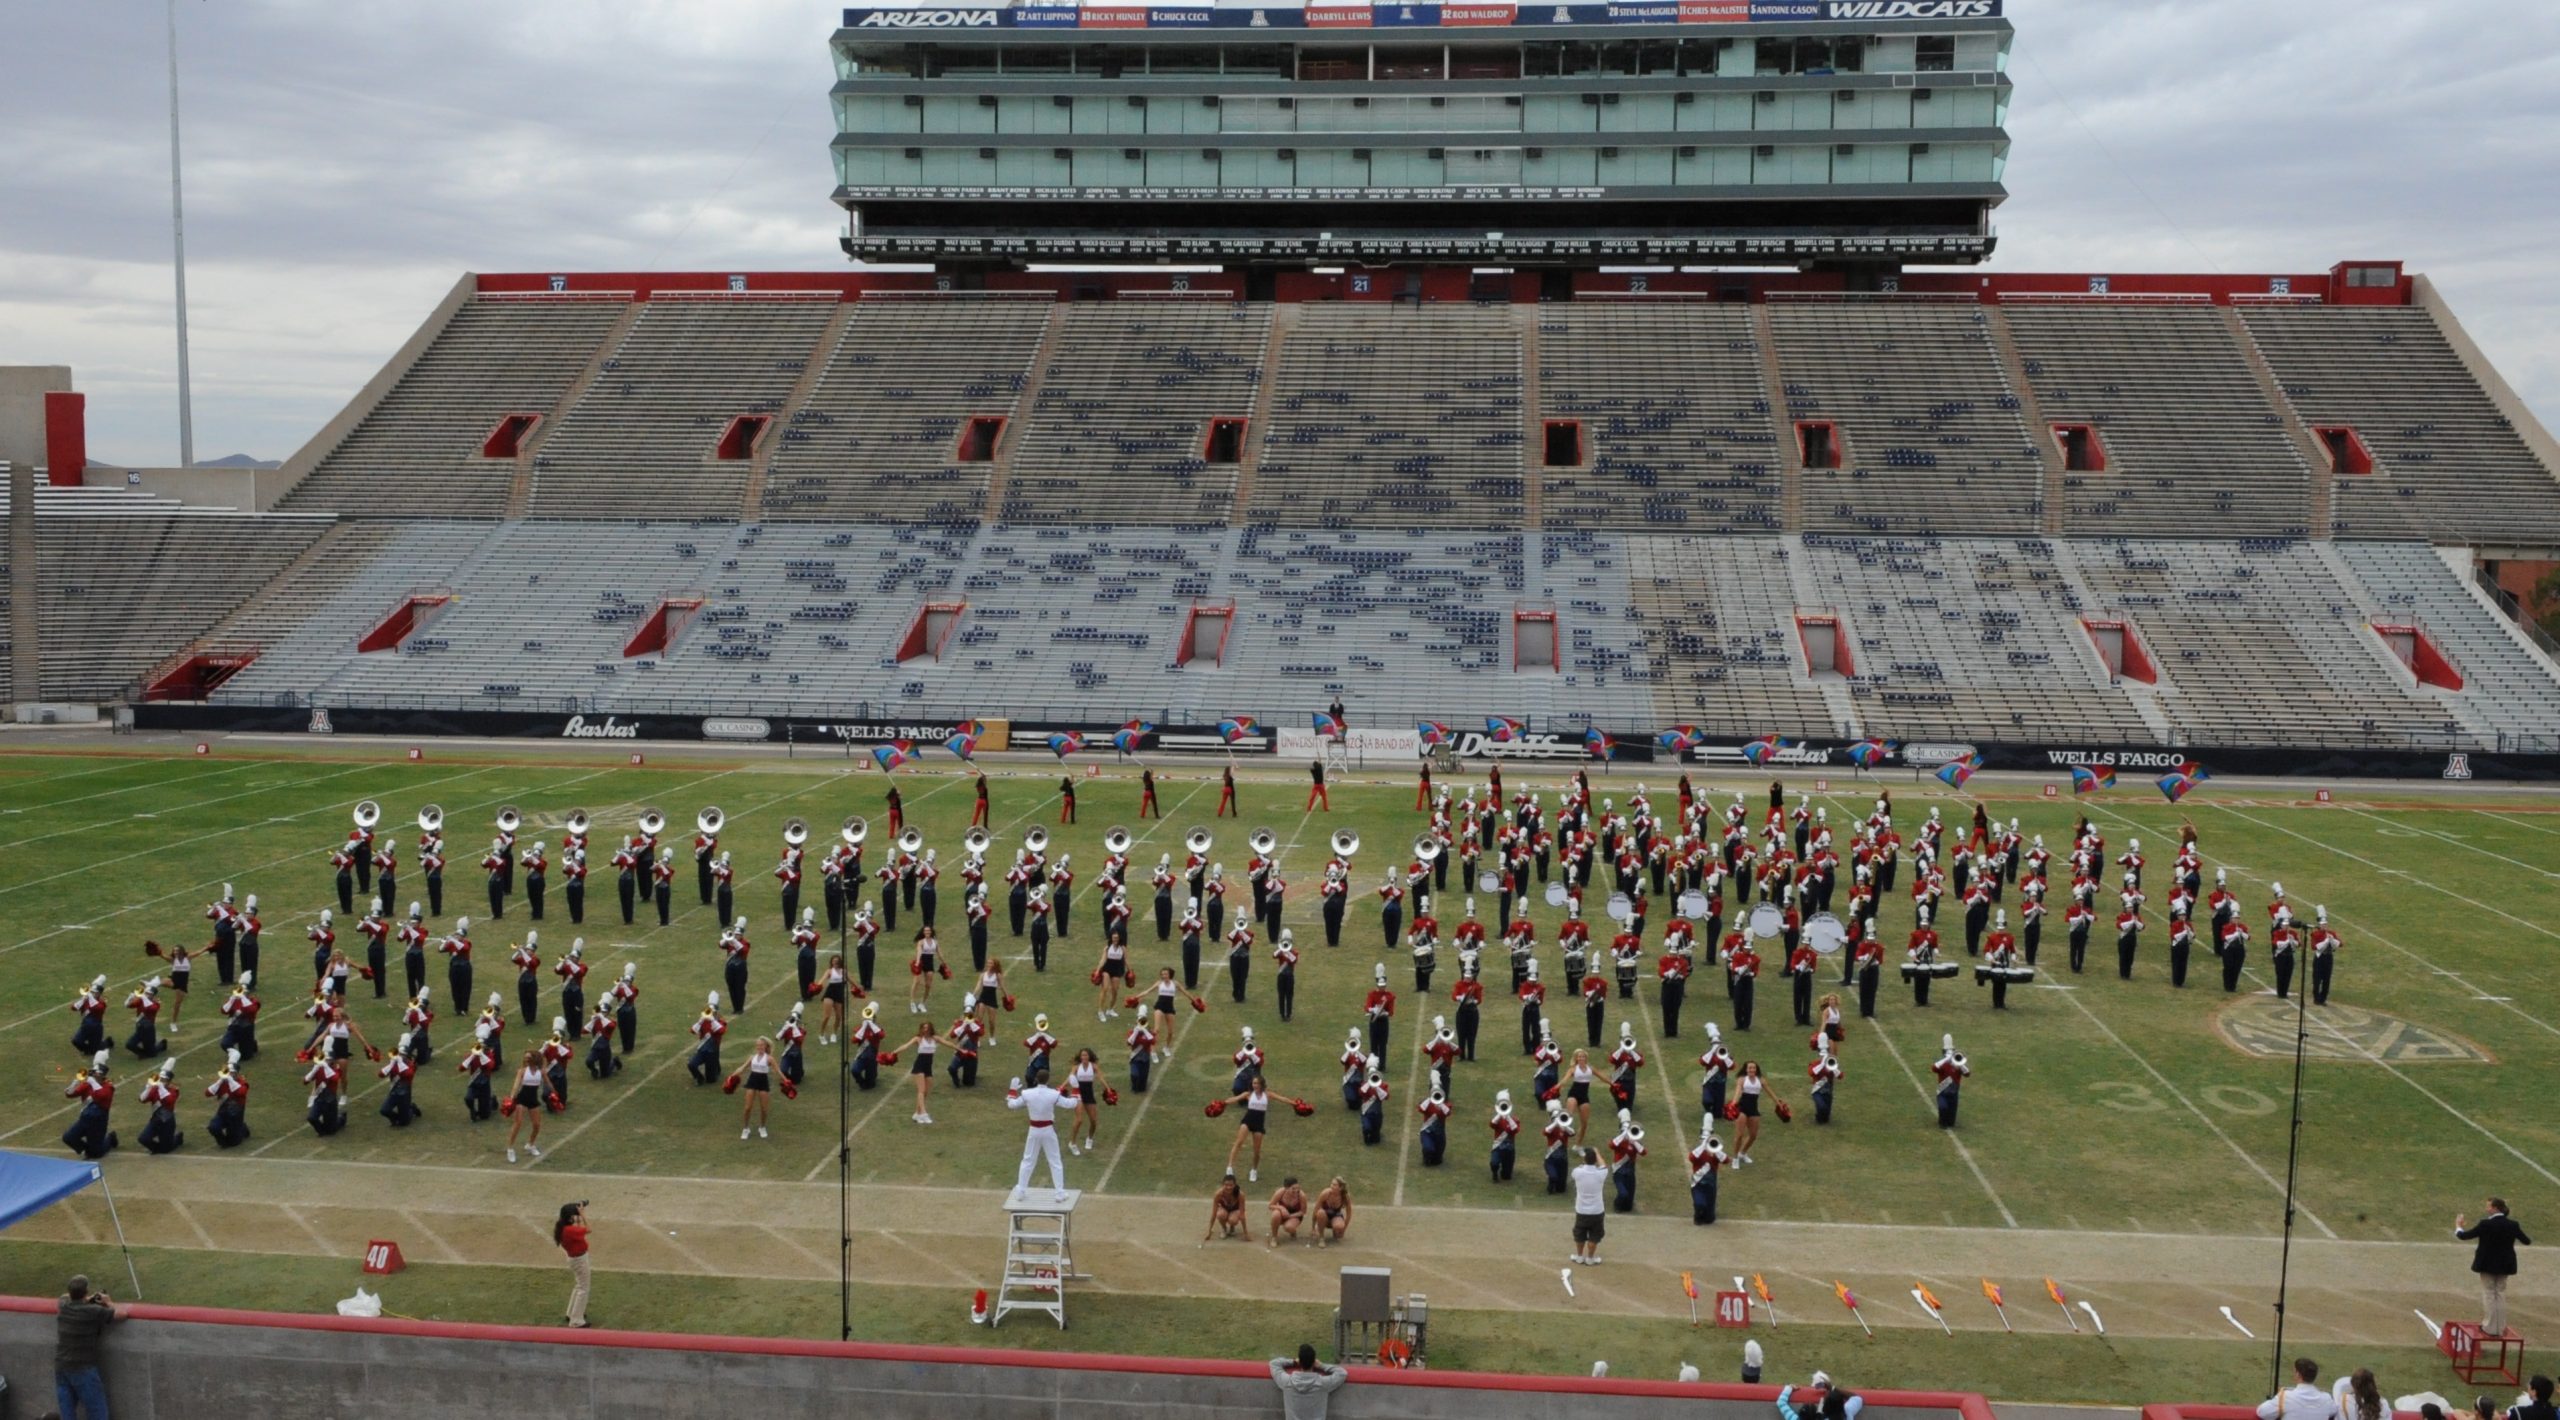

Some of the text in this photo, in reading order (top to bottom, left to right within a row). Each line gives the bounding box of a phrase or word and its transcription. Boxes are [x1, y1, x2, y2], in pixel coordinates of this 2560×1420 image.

[1619, 7, 1636, 16] STEVE
[1638, 7, 1677, 16] McLAUGHLIN
[1679, 6, 1748, 15] 11 CHRIS McALISTER
[1751, 5, 1818, 14] 5 ANTOINE CASON
[1830, 0, 1993, 17] WILDCATS
[859, 11, 998, 26] ARIZONA
[1017, 12, 1076, 20] 22 ART LUPPINO
[1092, 12, 1114, 20] RICKY
[1116, 12, 1145, 20] HUNLEY
[1159, 12, 1186, 21] CHUCK
[1188, 12, 1209, 21] CECIL
[1306, 12, 1371, 21] 4 DARRYLL LEWIS
[1442, 10, 1509, 19] 92 ROB WALDROP
[552, 281, 564, 291] 17
[731, 281, 744, 291] 18
[937, 281, 950, 290] 19
[1173, 281, 1188, 291] 20
[1354, 280, 1368, 291] 21
[1631, 282, 1646, 292] 22
[1882, 282, 1897, 292] 23
[2091, 283, 2106, 293] 24
[2272, 284, 2288, 294] 25
[129, 474, 139, 483] 16
[563, 715, 640, 738] Bashas'
[833, 725, 895, 739] WELLS
[1281, 737, 1323, 749] UNIVERSITY
[1375, 738, 1398, 750] BAND
[1399, 738, 1414, 750] DAY
[2048, 751, 2184, 767] WELLS FARGO
[367, 1245, 388, 1269] 40
[1721, 1297, 1743, 1321] 40
